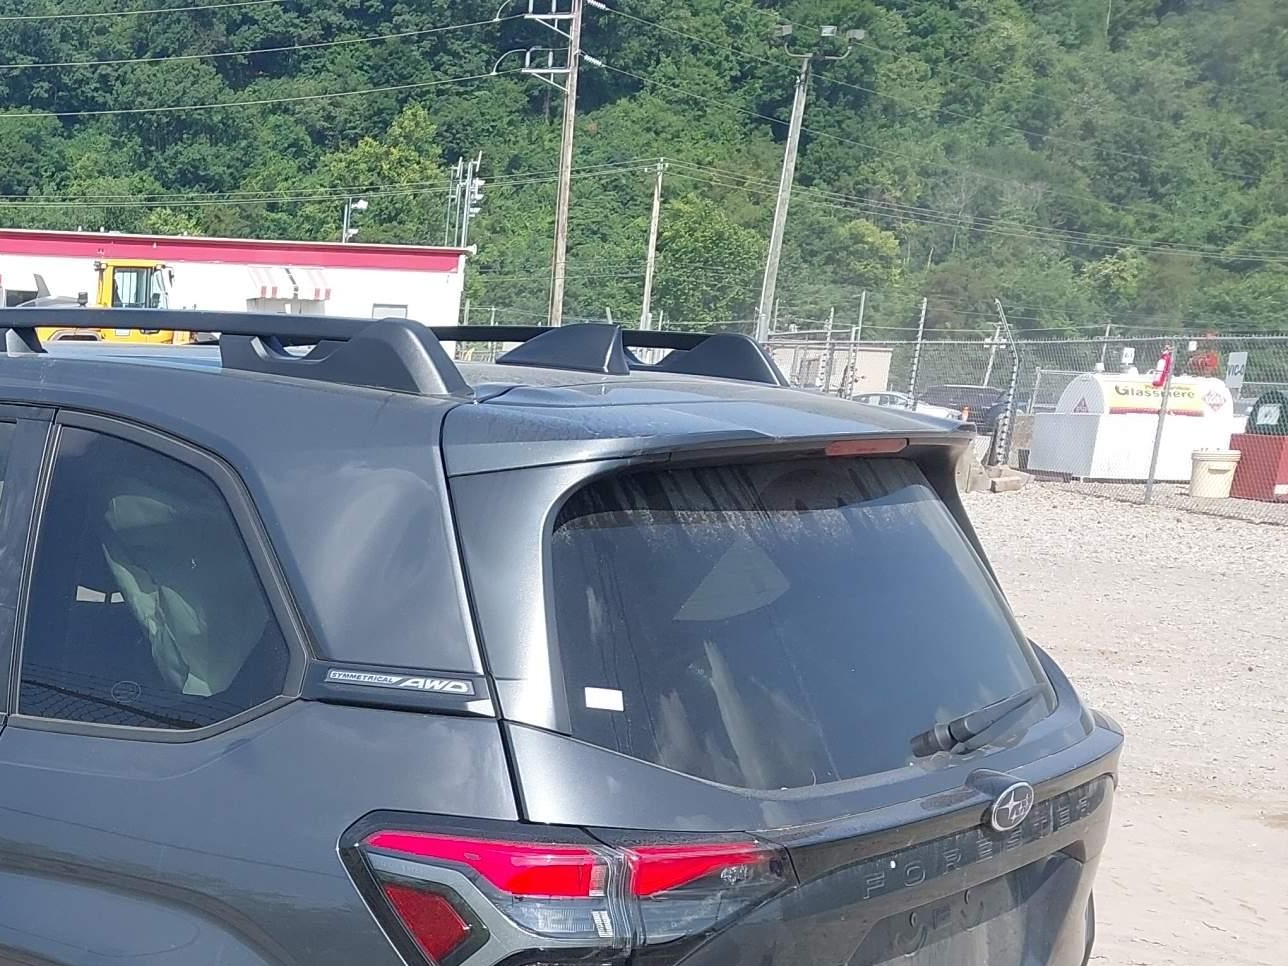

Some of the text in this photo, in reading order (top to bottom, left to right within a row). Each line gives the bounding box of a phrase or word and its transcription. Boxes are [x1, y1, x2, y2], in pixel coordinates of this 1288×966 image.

[331, 671, 469, 693] SYMMETRICAL AWD
[862, 796, 1091, 900] FORESTER
